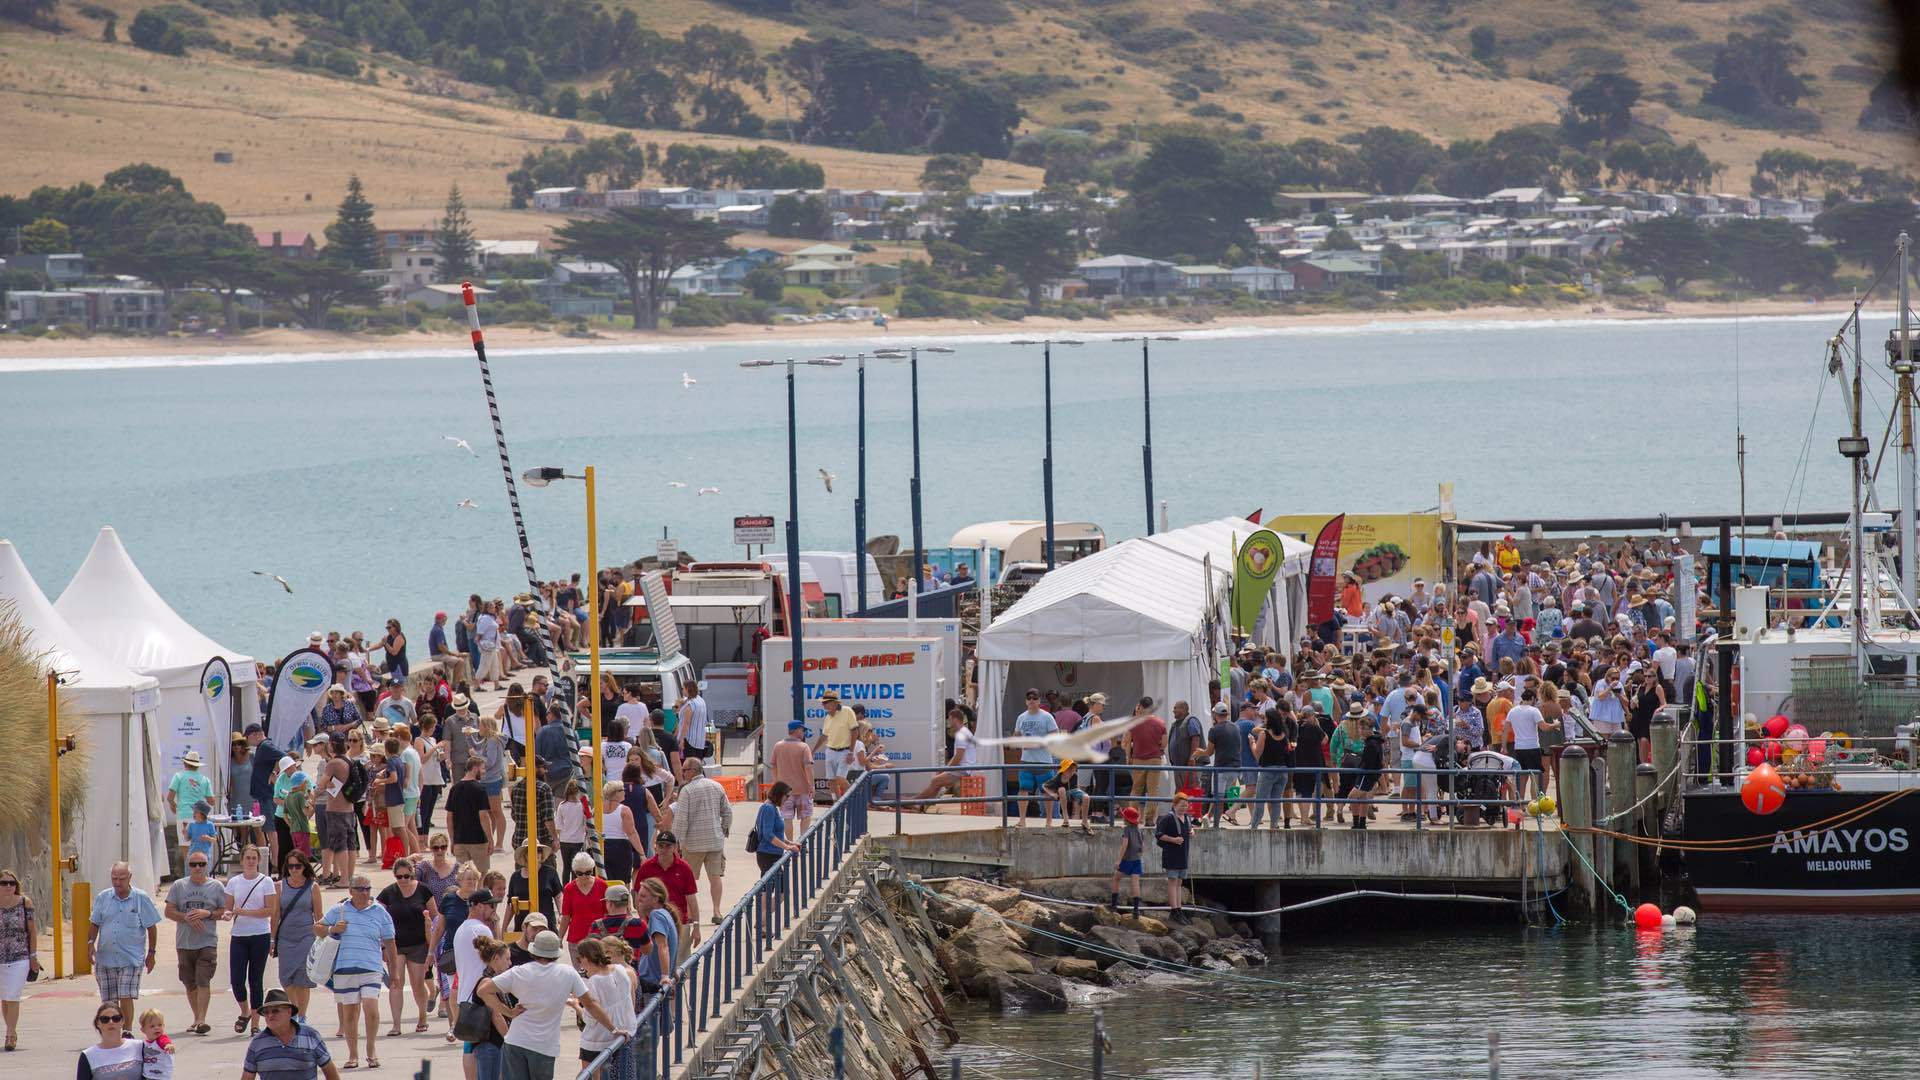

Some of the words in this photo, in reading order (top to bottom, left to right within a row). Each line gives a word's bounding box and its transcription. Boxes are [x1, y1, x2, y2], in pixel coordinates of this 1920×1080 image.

[849, 652, 915, 669] HIRE
[790, 683, 905, 700] TATEWIDE
[1770, 827, 1910, 855] AMAYOS
[1807, 859, 1872, 872] MELBOURNE
